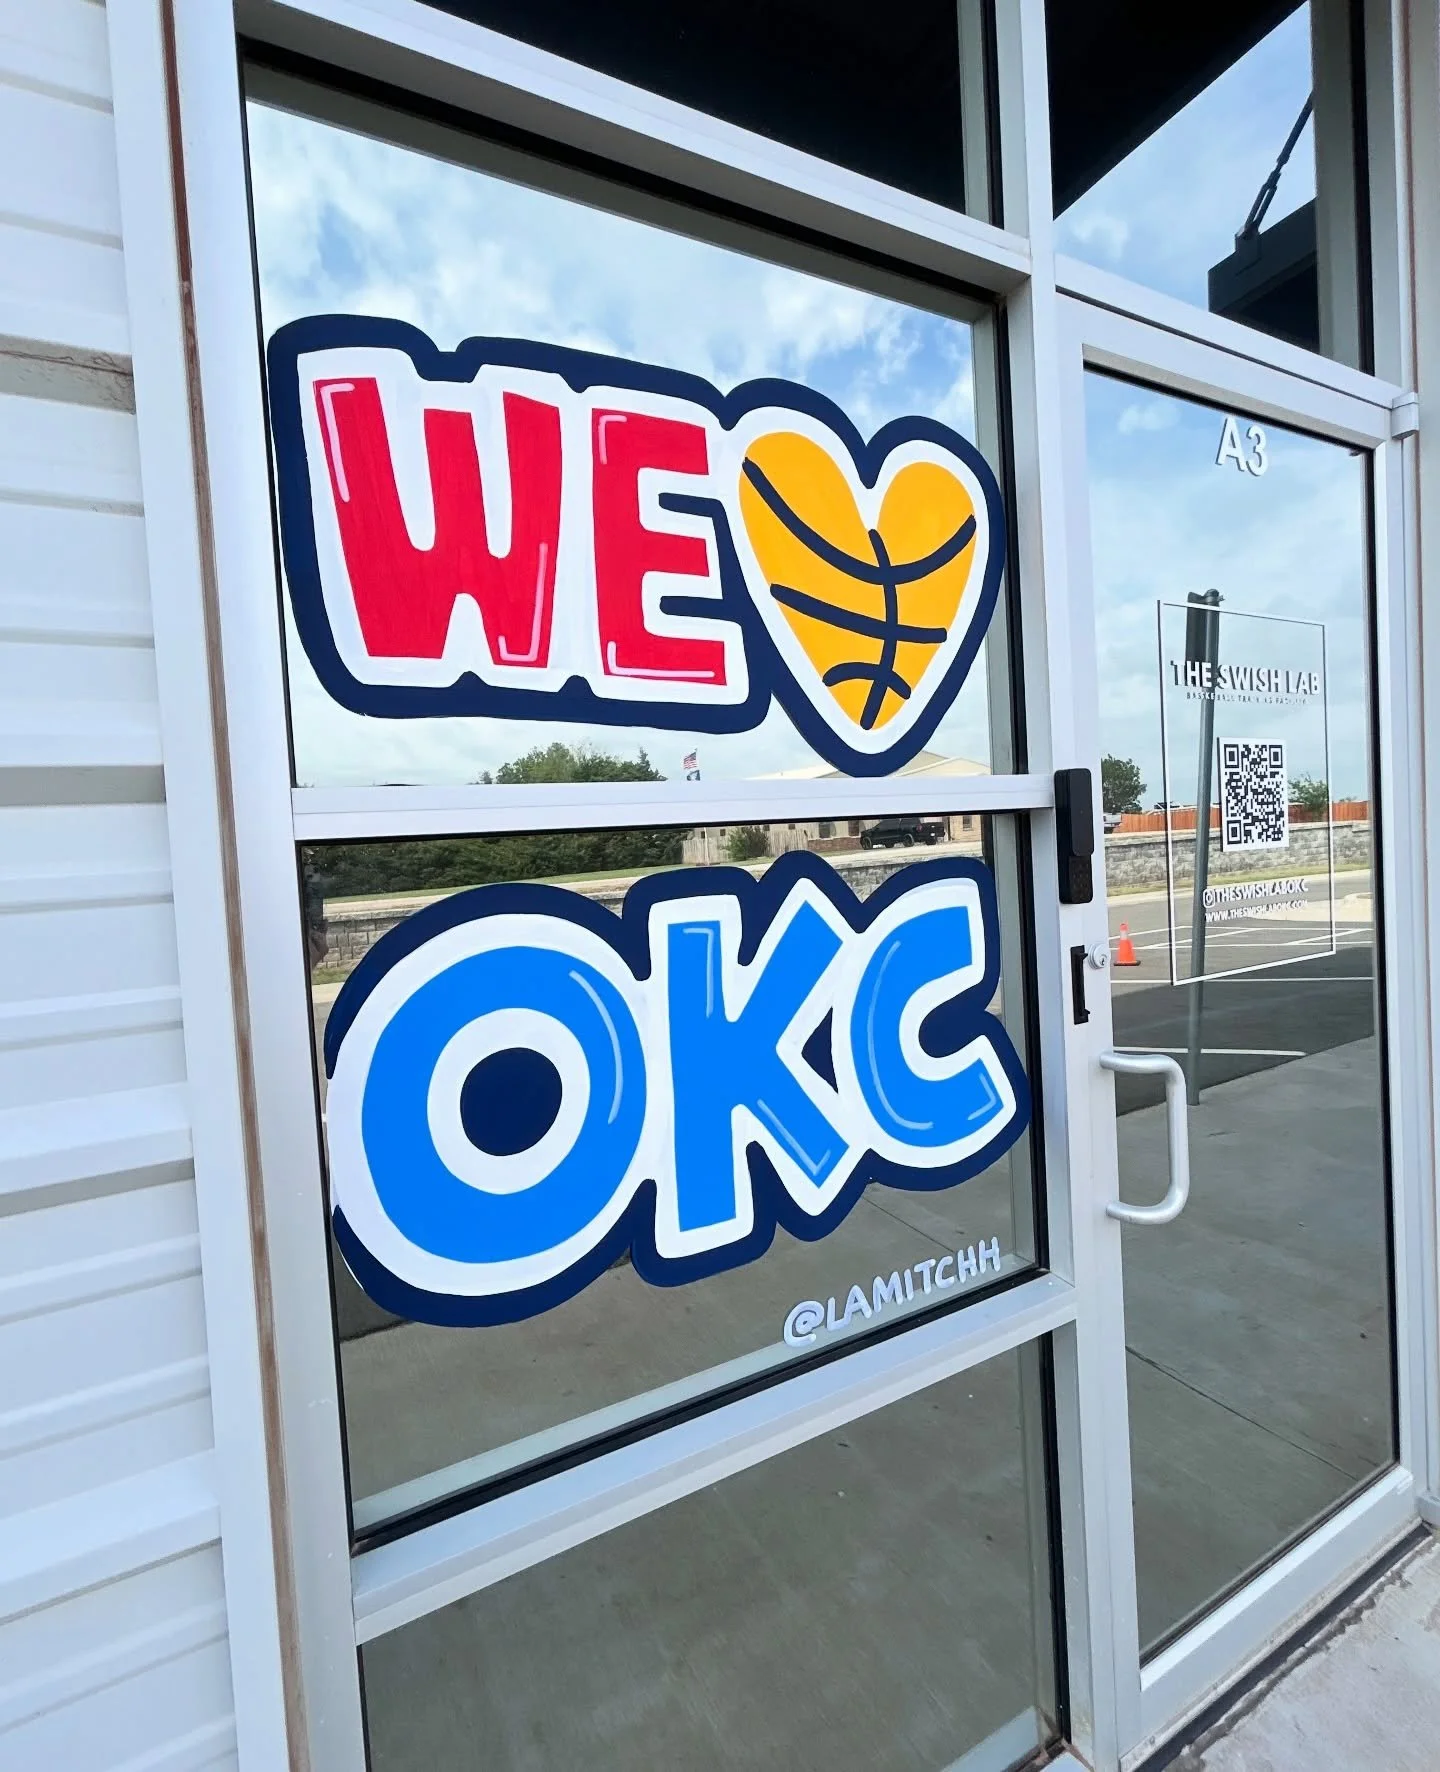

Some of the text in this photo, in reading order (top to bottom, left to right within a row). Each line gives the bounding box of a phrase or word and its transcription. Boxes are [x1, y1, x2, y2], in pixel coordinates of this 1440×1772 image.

[1215, 416, 1269, 477] A3
[312, 377, 727, 686] WE
[1170, 660, 1320, 695] THE SWISH LAB
[1186, 691, 1235, 702] BASKEBALL
[361, 900, 1004, 1264] OKC
[783, 1236, 1001, 1347] @LAMITCHH
